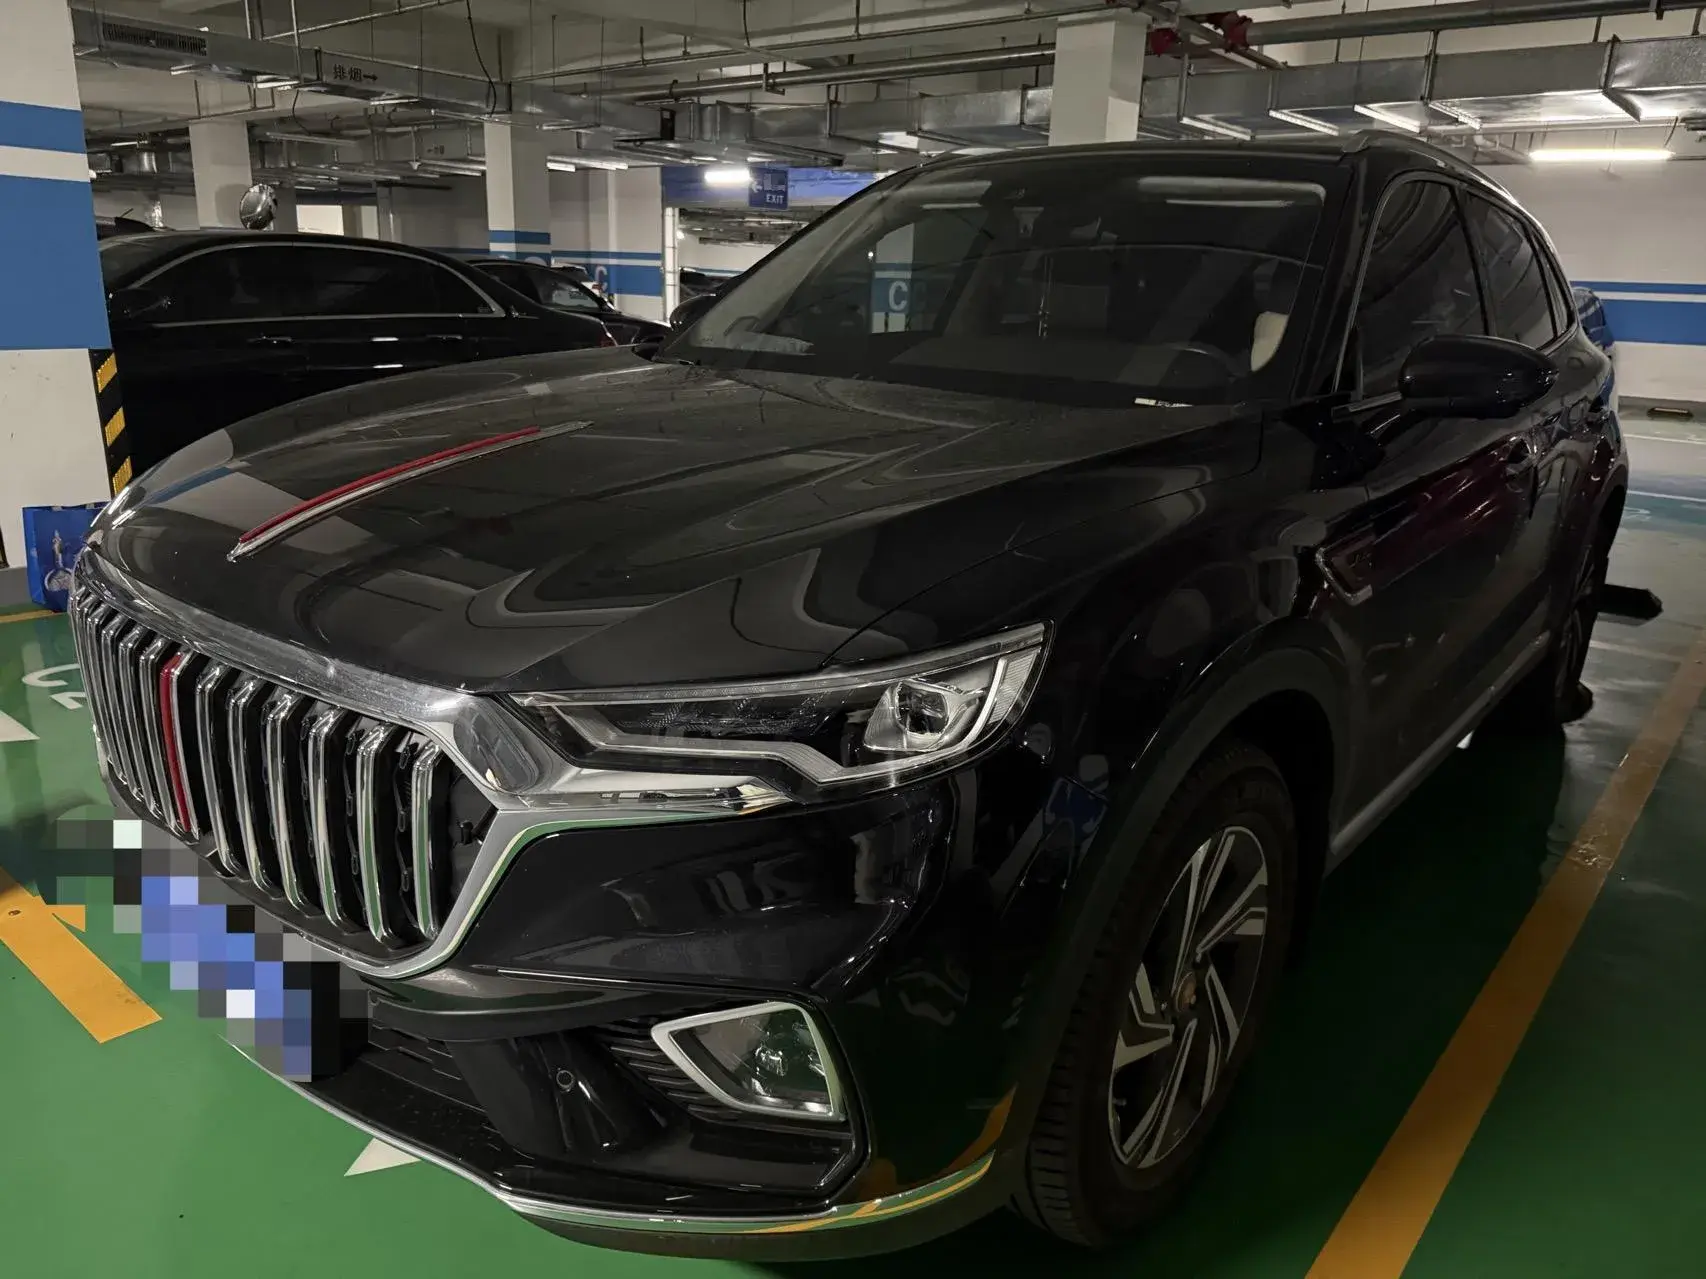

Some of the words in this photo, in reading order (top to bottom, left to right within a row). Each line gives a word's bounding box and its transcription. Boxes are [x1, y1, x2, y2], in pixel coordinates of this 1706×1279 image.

[332, 63, 362, 82] 排烟
[766, 194, 785, 205] EXIT
[889, 280, 908, 311] C
